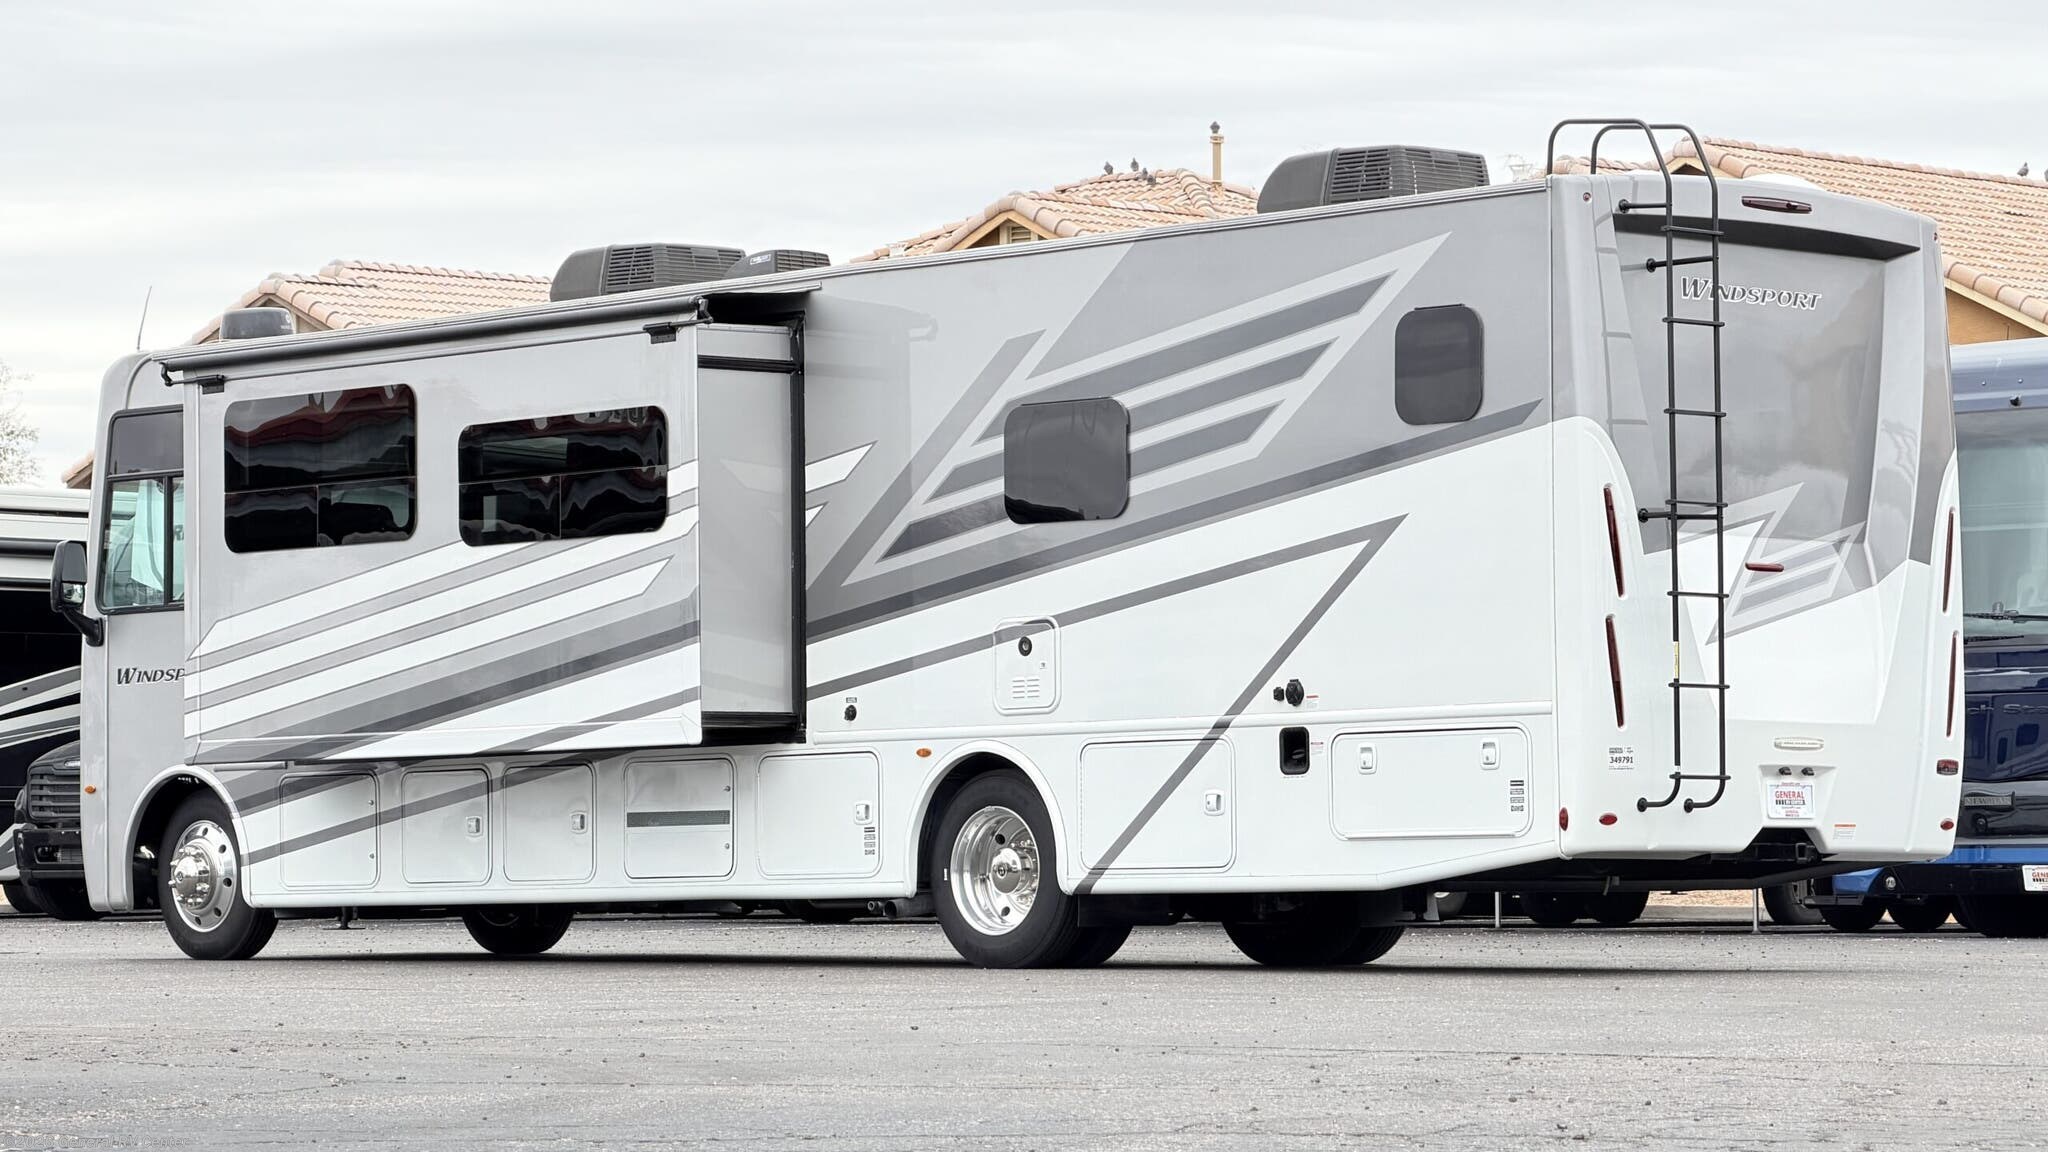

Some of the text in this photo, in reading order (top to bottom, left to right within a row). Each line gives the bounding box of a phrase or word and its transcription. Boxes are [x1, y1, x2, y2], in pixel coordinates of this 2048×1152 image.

[1681, 276, 1822, 311] WINDSPORT
[1609, 756, 1634, 764] 349791
[1774, 790, 1805, 799] GENERAL
